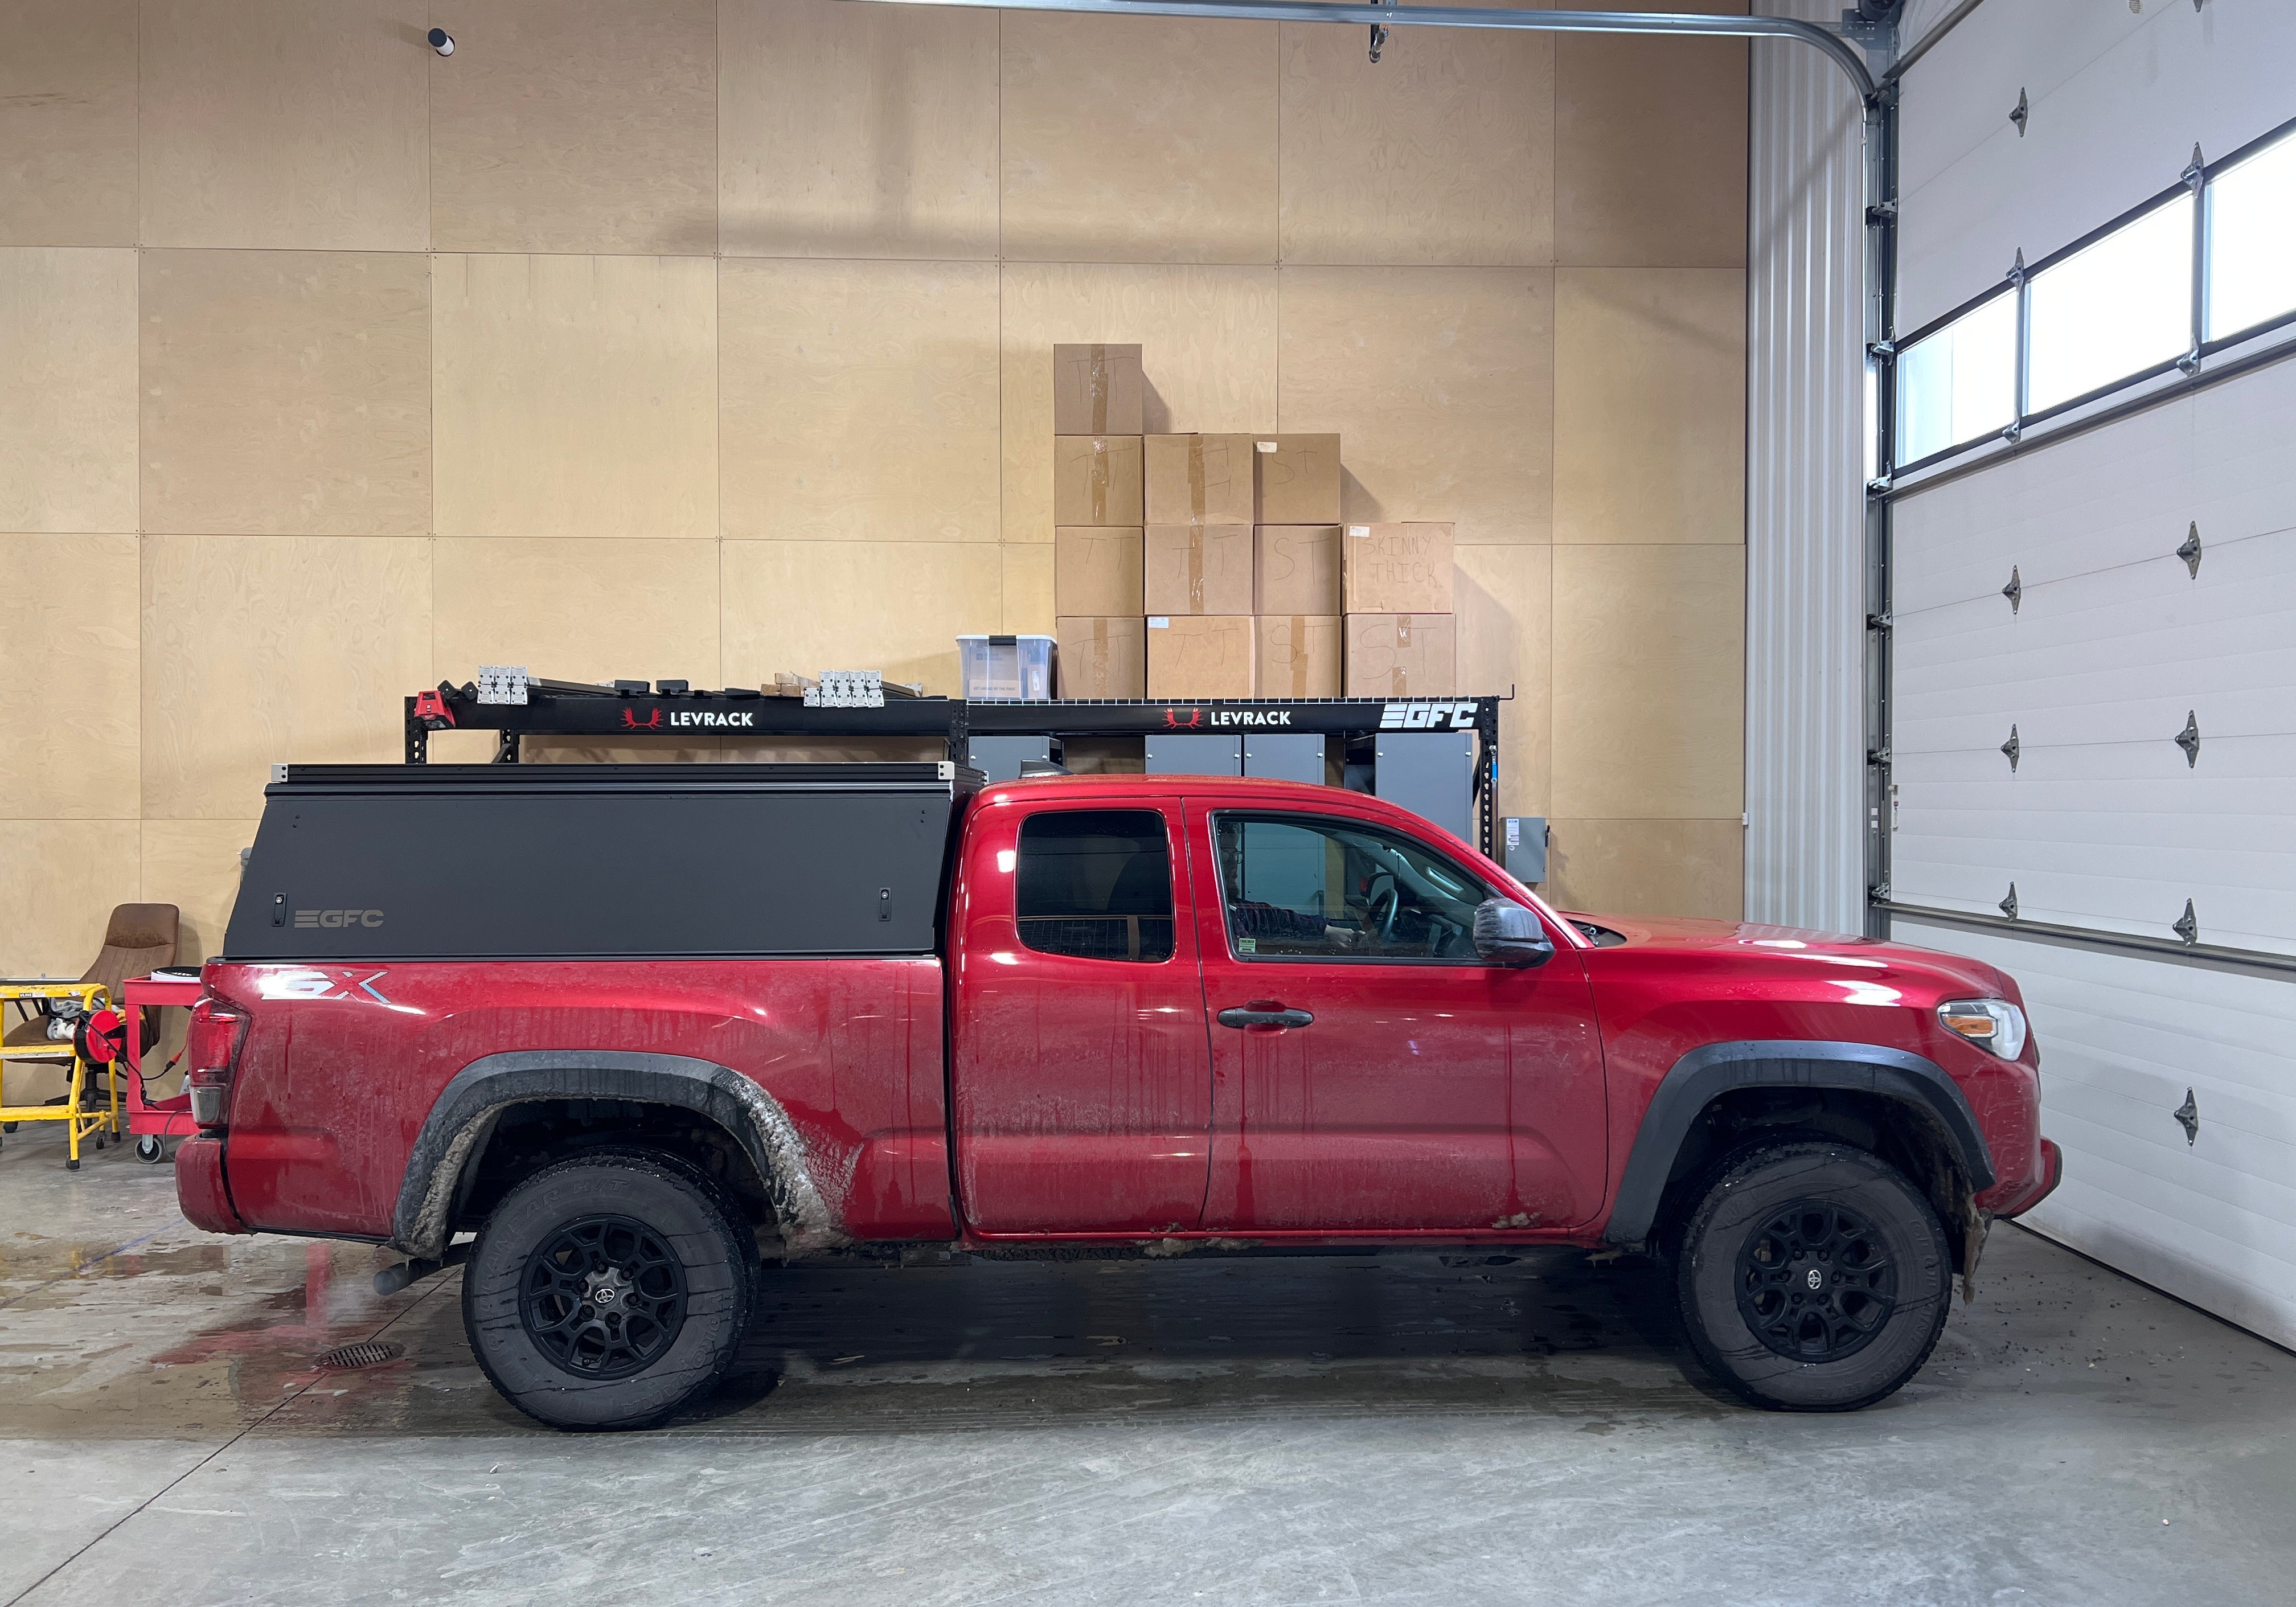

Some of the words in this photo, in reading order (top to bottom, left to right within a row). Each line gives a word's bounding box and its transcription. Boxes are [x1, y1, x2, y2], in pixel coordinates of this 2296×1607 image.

[1363, 536, 1433, 556] SKINNY
[1370, 561, 1438, 589] THICK
[670, 712, 753, 727] LEVRACK
[1211, 711, 1291, 725] LEVRACK
